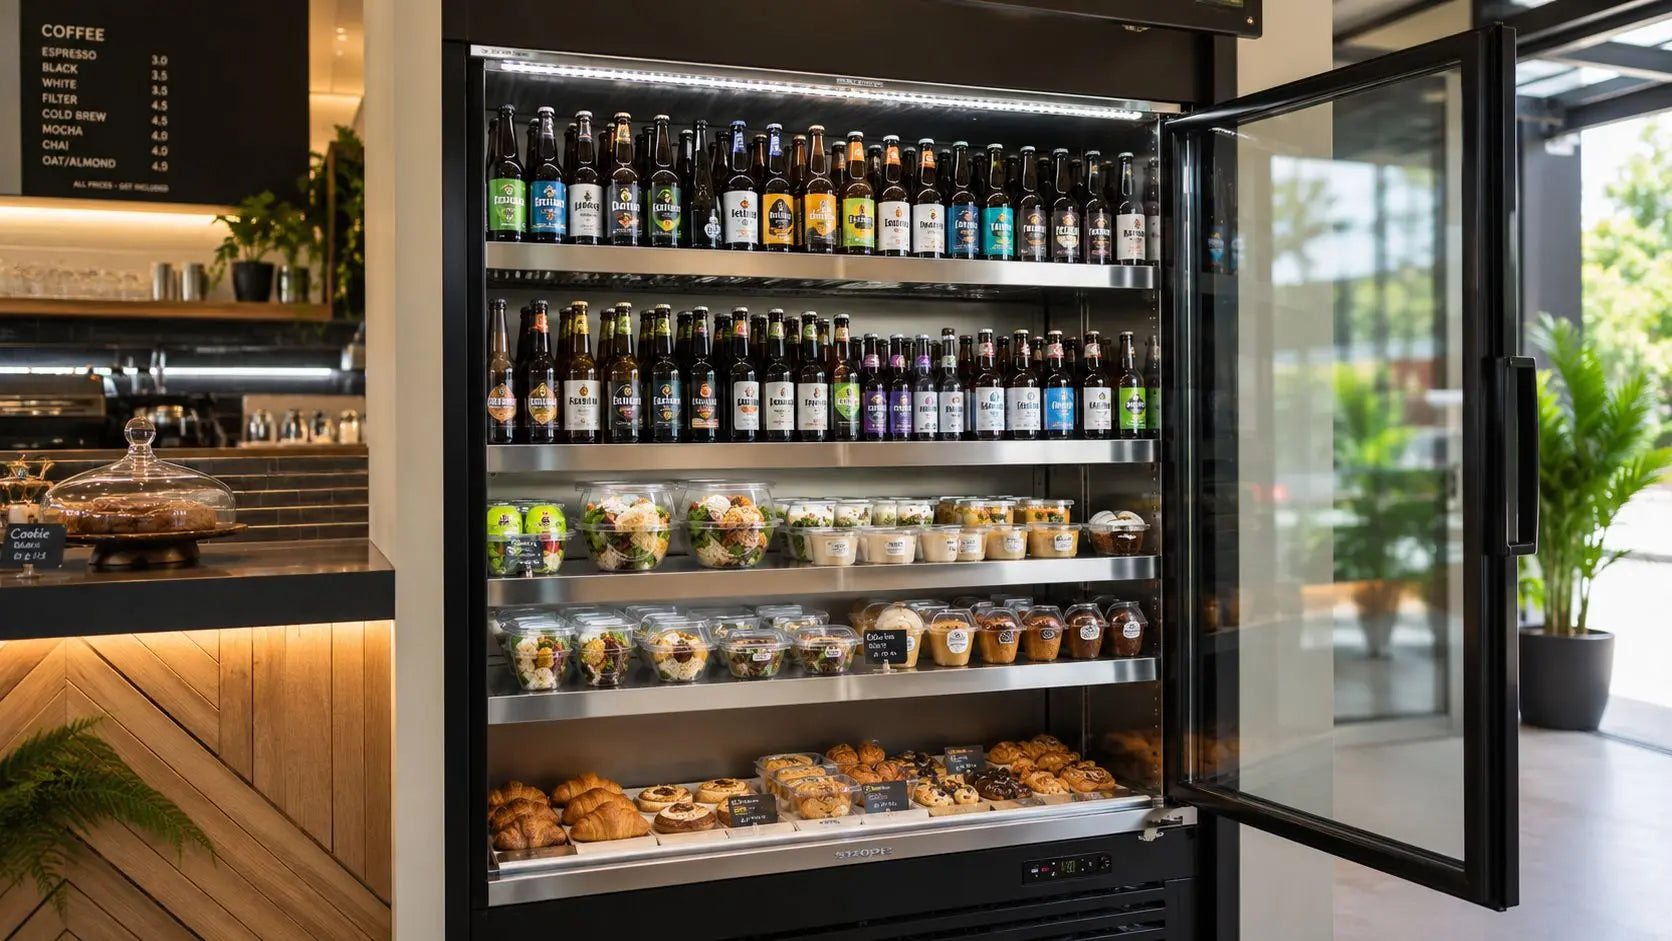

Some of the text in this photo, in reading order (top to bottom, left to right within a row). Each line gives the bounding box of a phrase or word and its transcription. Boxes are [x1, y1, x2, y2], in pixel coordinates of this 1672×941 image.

[41, 24, 105, 41] COFFEE
[41, 47, 168, 65] ESPRESSO 3.0
[41, 62, 168, 81] BLACK 3.5
[41, 78, 168, 96] WHITE 3.5
[41, 93, 168, 111] FILTER 4.5
[41, 109, 168, 127] COLD BREW 4.5
[41, 125, 168, 142] MOCHA 4.0
[41, 140, 168, 157] CHAI 4.0
[41, 155, 168, 172] OAT/ALMOND 4.0
